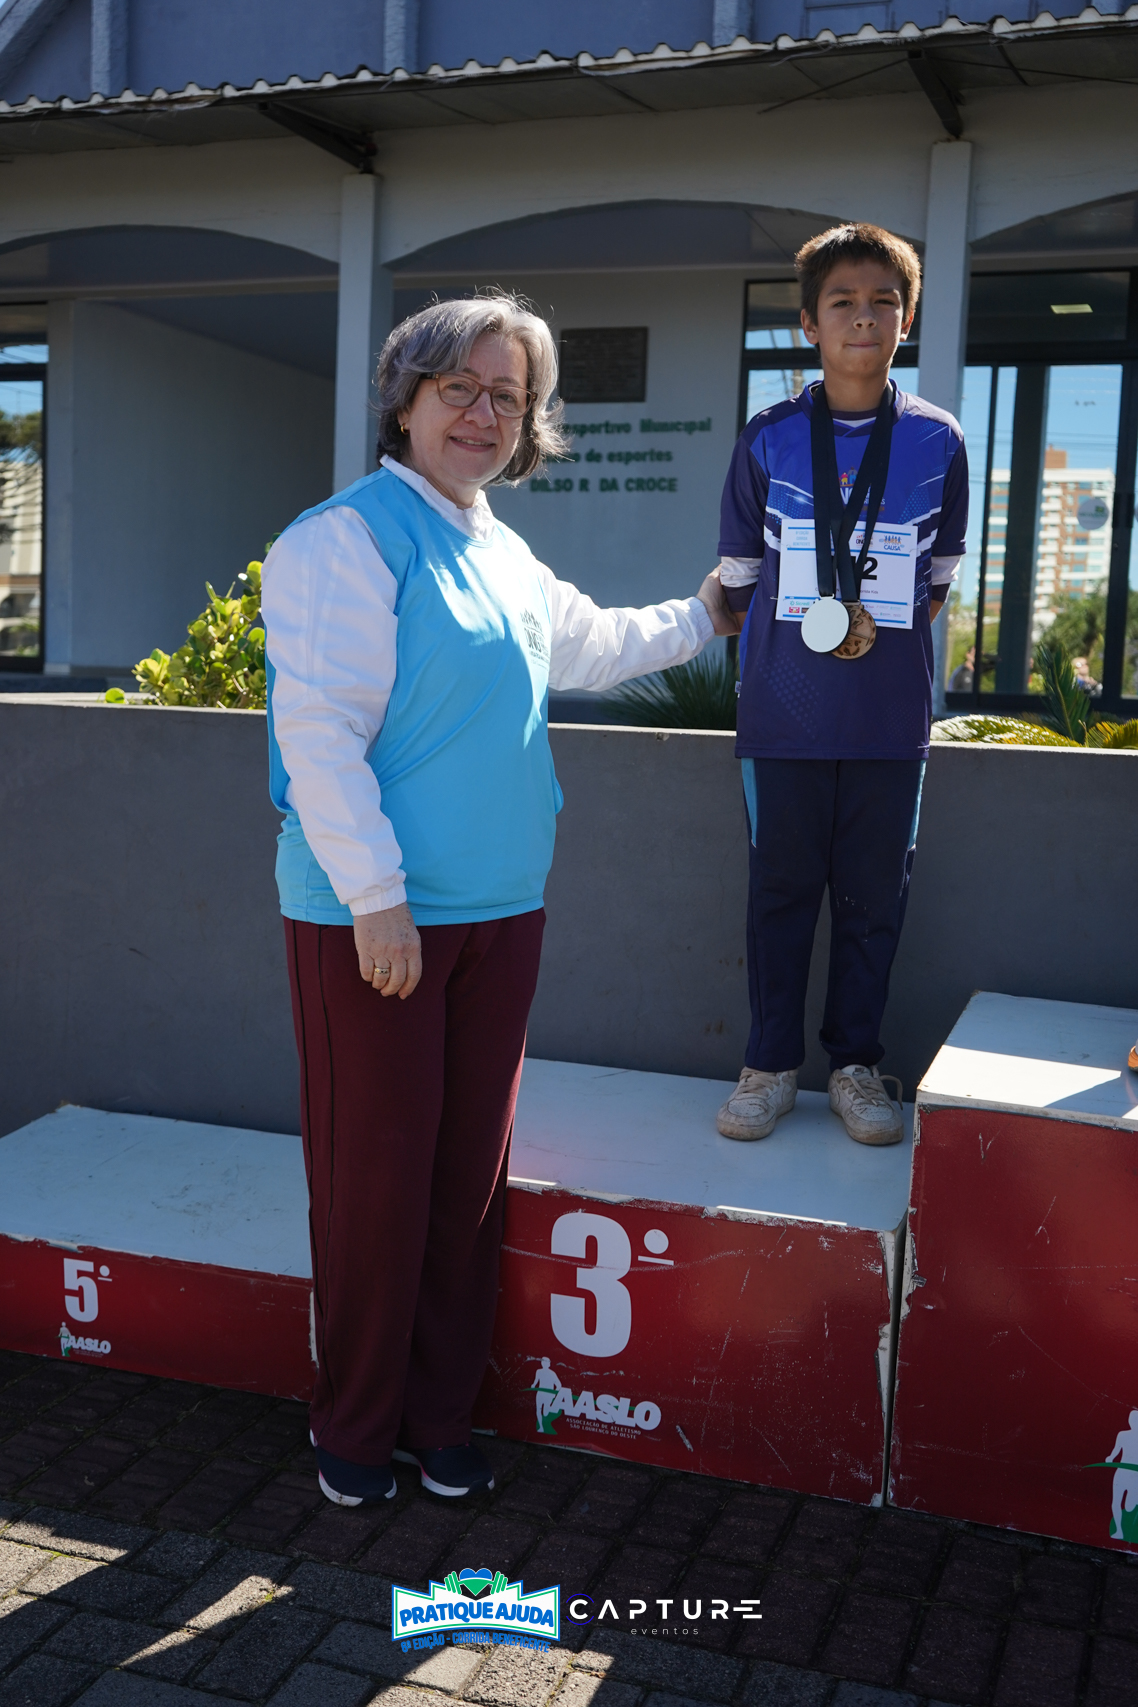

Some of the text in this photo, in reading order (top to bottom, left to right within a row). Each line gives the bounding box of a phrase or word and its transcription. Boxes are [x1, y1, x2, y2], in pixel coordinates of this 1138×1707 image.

[640, 417, 712, 435] Municipal
[585, 449, 602, 462] de
[607, 450, 673, 464] esportes
[530, 478, 574, 492] DILSO
[600, 478, 619, 492] DA
[625, 477, 678, 492] CROCE
[69, 1335, 112, 1355] AASLO
[549, 1387, 662, 1431] AASLO
[566, 1417, 600, 1429] ASSOCIAÇÃO
[610, 1425, 641, 1436] ATLETISMO
[569, 1422, 637, 1440] SÃO LOURENÇO DO OESTE
